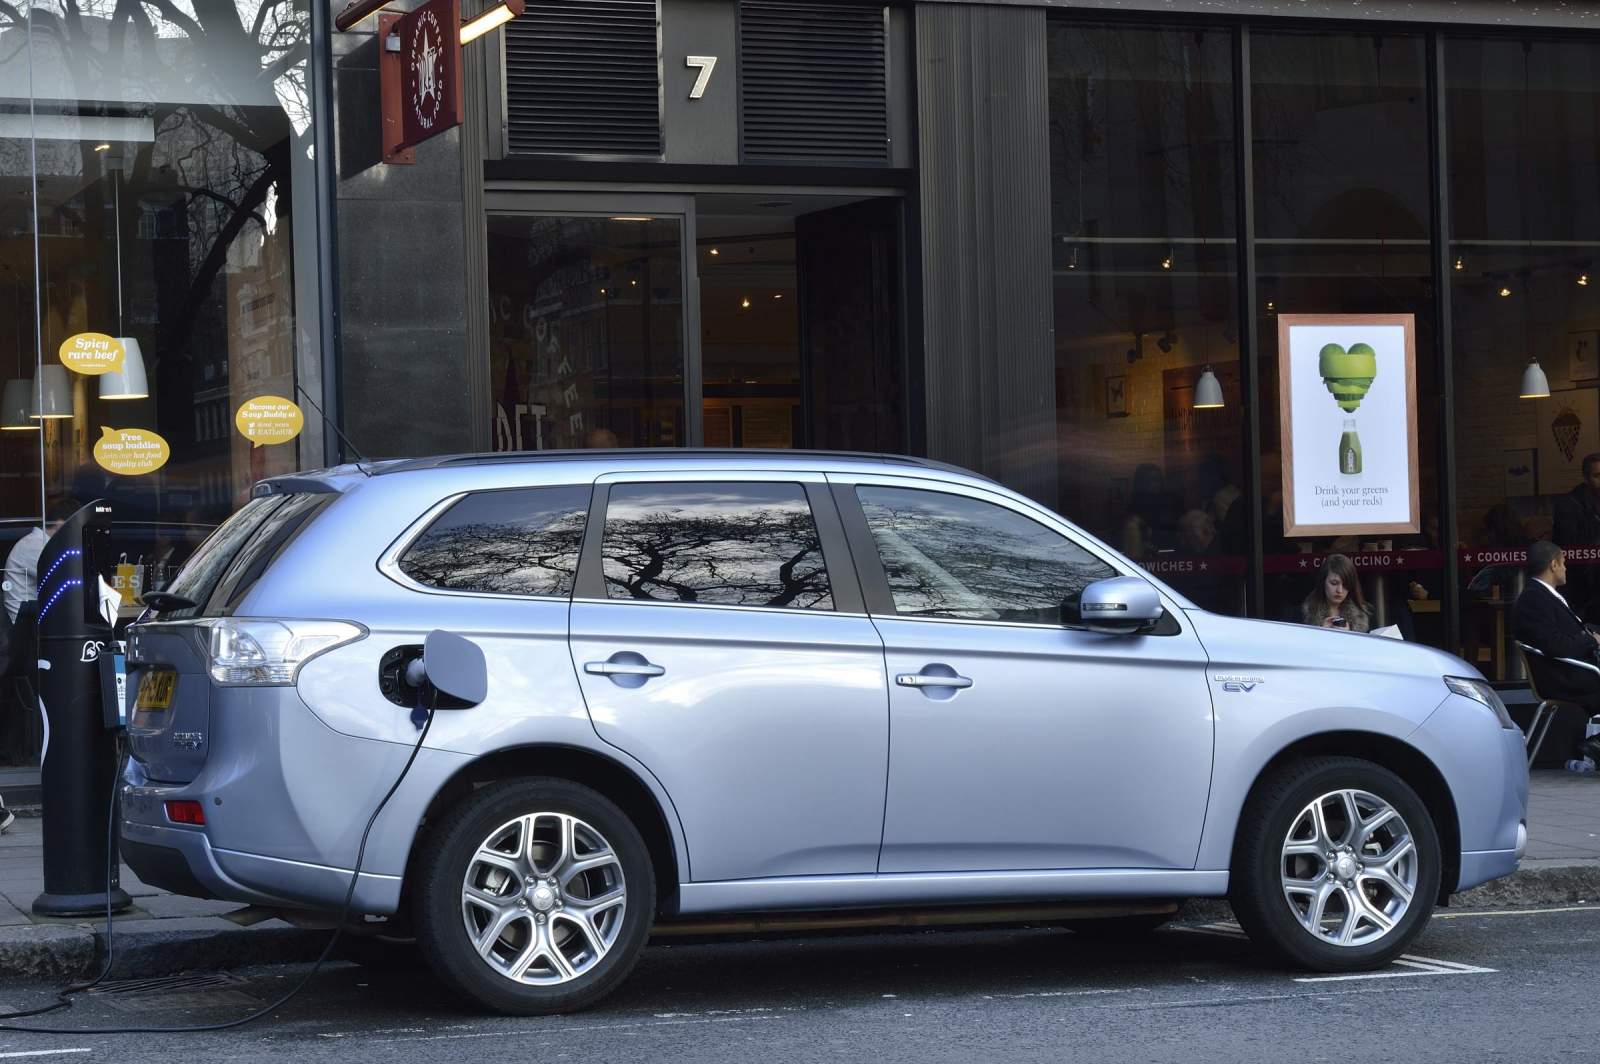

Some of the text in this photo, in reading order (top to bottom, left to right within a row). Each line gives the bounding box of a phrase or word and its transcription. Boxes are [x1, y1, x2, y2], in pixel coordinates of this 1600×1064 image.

[687, 56, 717, 98] 7
[75, 338, 109, 351] Spicy
[68, 349, 119, 362] rare beef
[120, 433, 142, 441] Free
[1315, 485, 1388, 497] Drink your greens
[1321, 496, 1383, 509] (and your reds)
[1477, 551, 1528, 562] COOKIES
